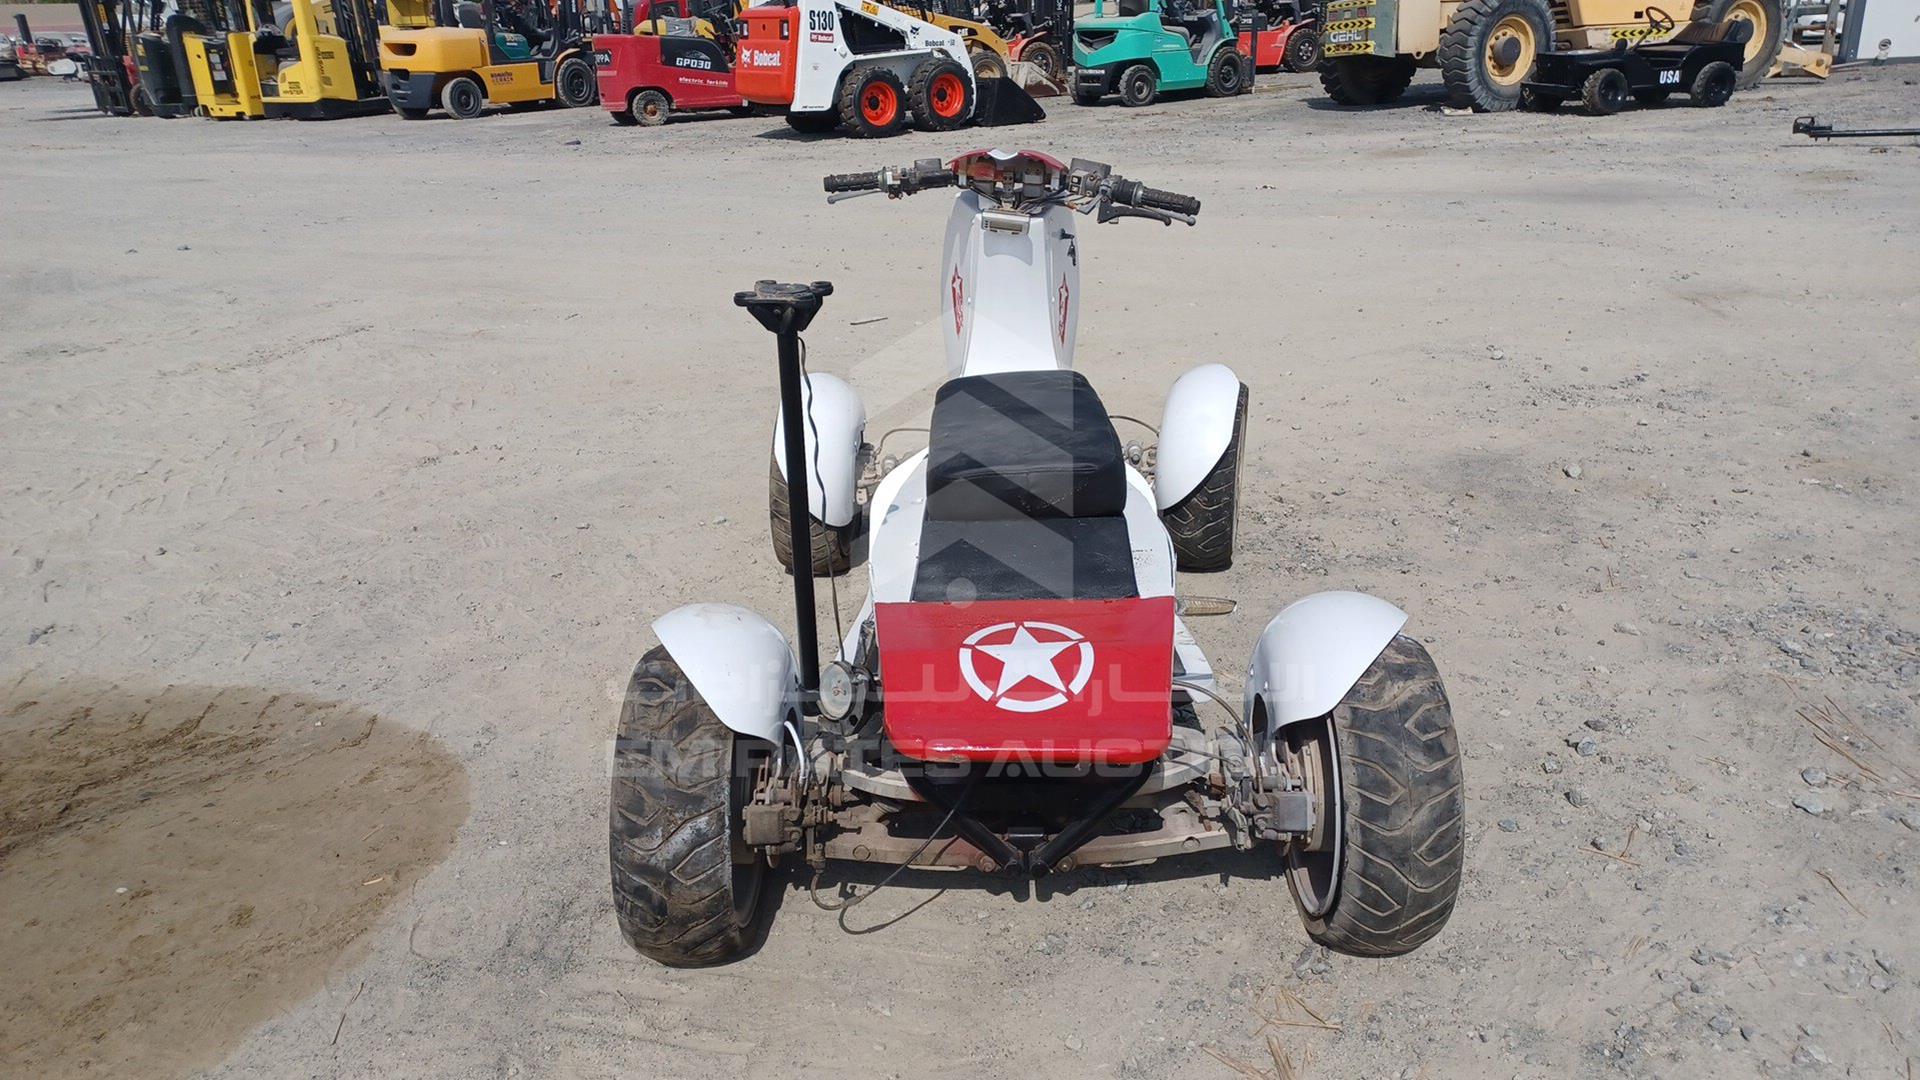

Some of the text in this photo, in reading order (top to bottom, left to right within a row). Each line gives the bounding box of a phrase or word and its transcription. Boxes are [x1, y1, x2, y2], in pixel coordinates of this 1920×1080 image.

[809, 10, 834, 31] S130
[753, 49, 782, 67] Bobcat
[1660, 70, 1679, 84] USA
